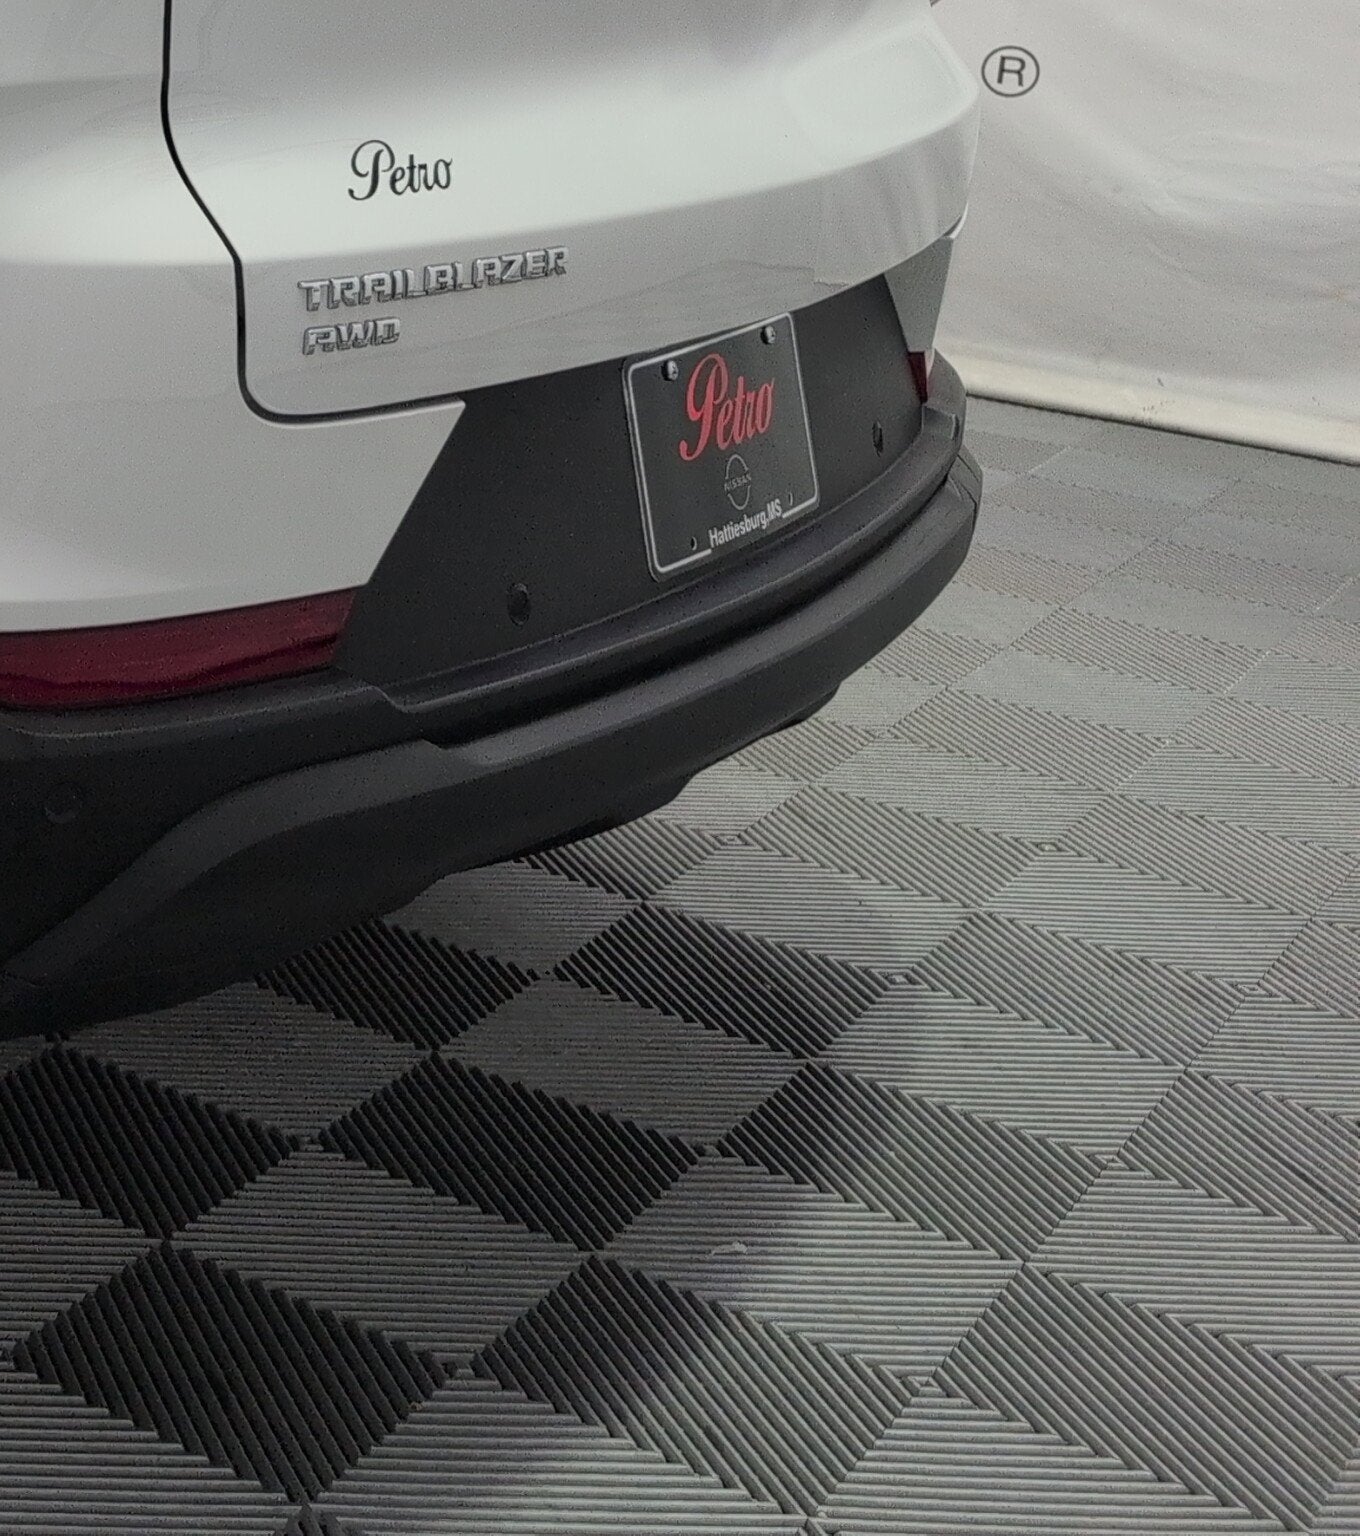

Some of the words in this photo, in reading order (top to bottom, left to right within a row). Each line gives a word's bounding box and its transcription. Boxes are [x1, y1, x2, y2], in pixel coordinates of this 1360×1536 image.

[347, 139, 454, 201] Petro
[297, 245, 570, 313] TRAILBLAZER
[302, 316, 401, 356] AWD
[679, 353, 776, 461] Petro
